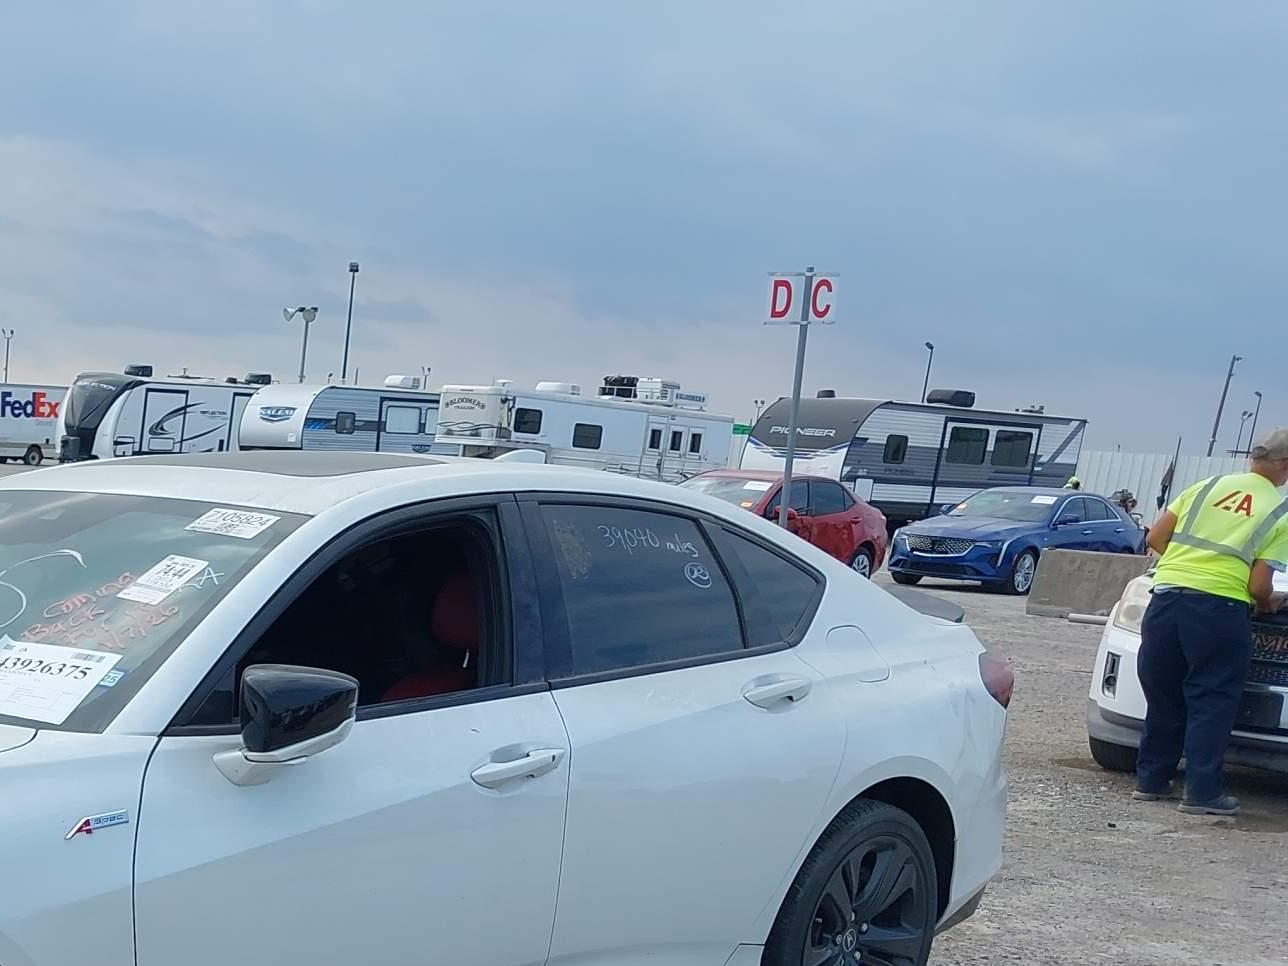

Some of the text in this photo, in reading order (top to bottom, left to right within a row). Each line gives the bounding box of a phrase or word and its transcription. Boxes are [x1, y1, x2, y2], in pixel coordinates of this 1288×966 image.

[771, 279, 833, 318] D C
[0, 391, 61, 418] FedEx
